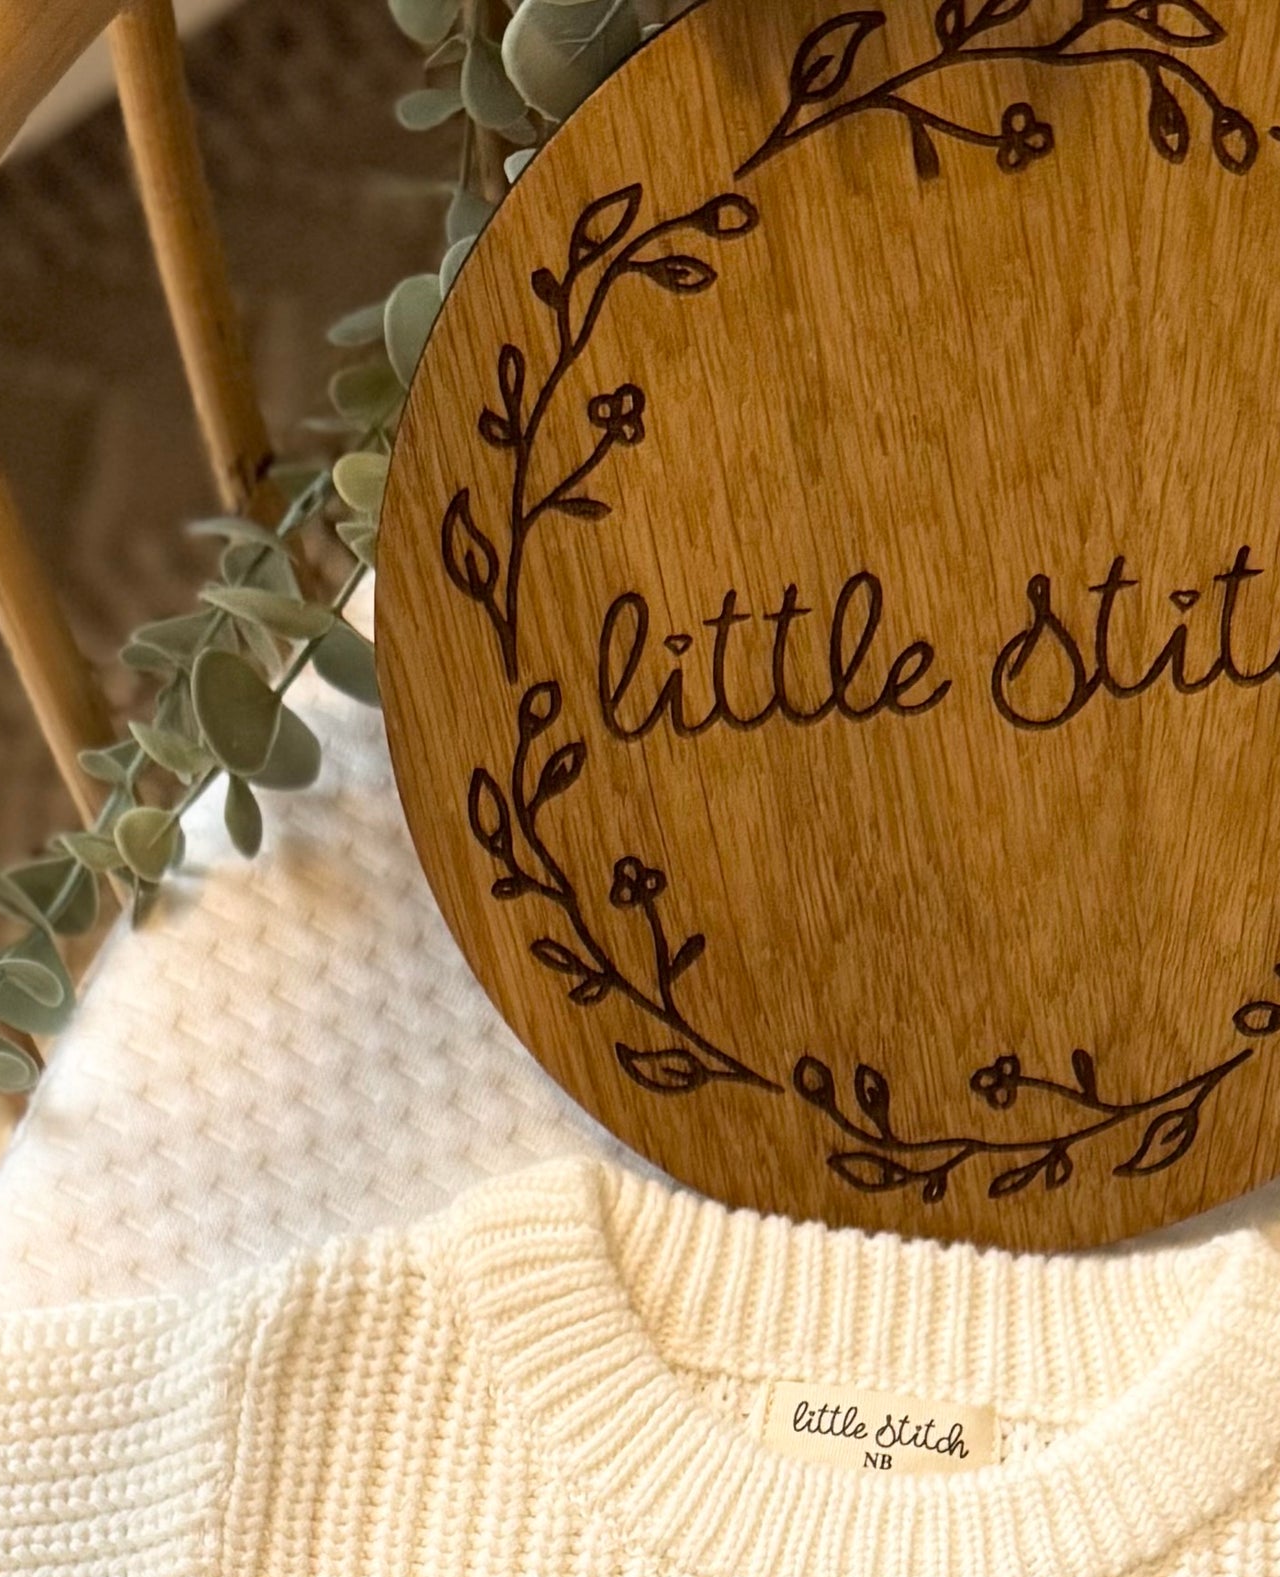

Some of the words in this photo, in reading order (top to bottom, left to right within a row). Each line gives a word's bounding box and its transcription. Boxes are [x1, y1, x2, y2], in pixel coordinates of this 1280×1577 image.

[599, 571, 952, 742] little
[792, 1400, 869, 1440] little
[862, 1451, 894, 1471] NB
